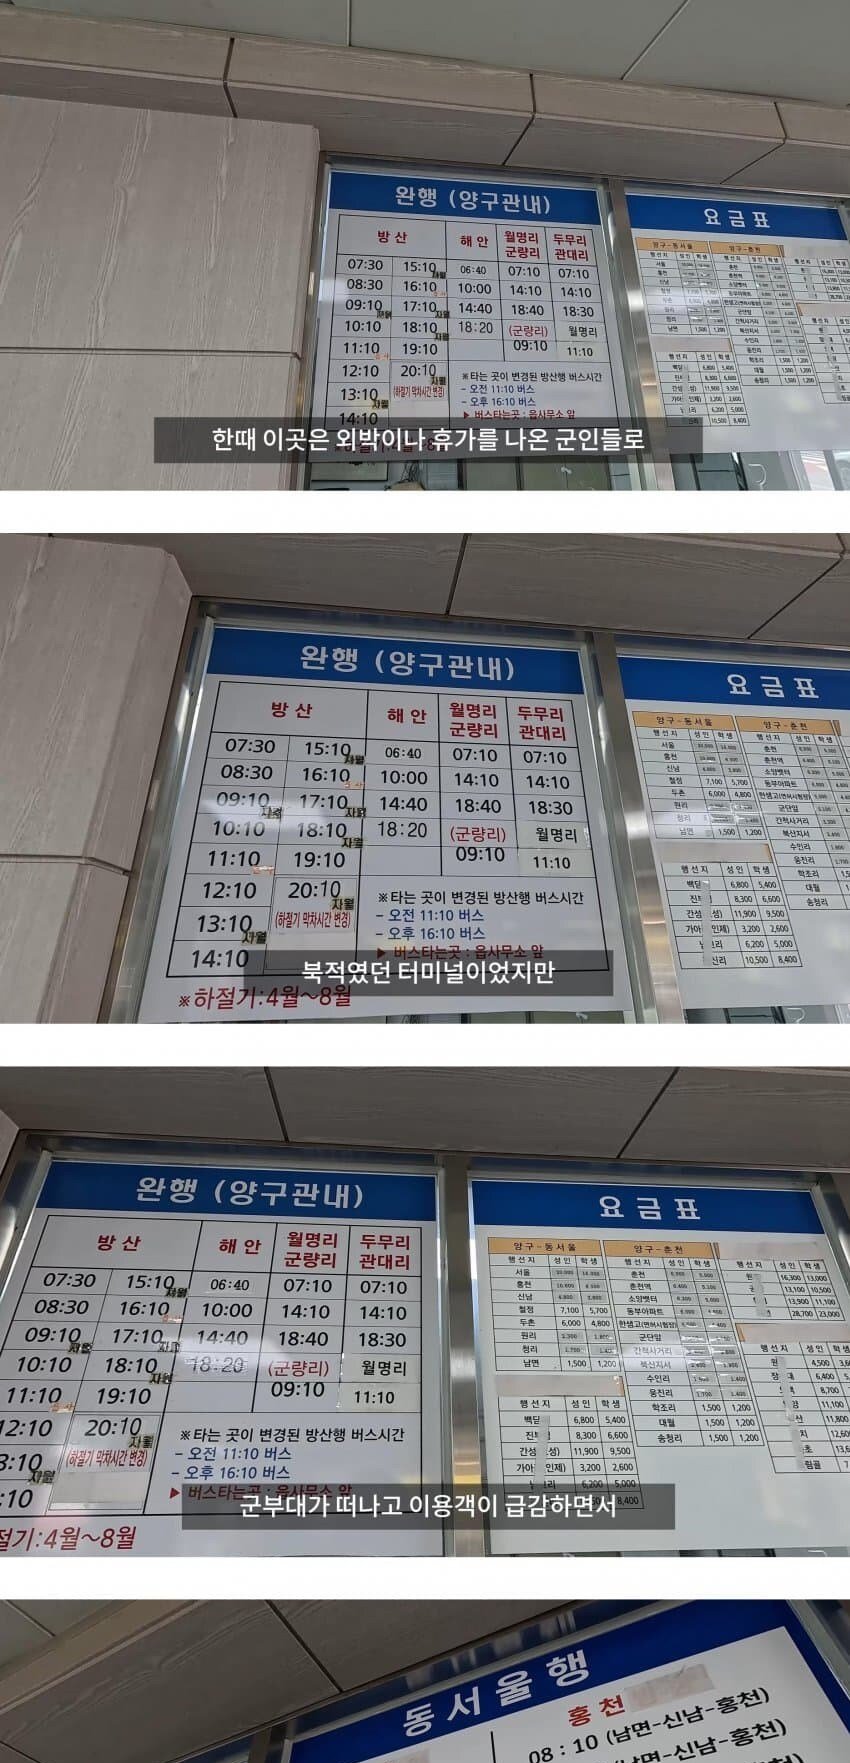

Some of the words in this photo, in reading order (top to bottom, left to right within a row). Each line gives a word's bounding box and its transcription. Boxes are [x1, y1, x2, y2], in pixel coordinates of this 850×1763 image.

[395, 186, 438, 208] 완행
[449, 189, 550, 215] (양구관내)
[504, 230, 538, 244] 월명리
[508, 266, 540, 278] 07:10
[300, 645, 358, 673] 완행
[375, 650, 514, 681] (양구관내)
[450, 702, 496, 719] 월명리
[517, 706, 564, 722] 두무리
[450, 722, 498, 739] 군량리
[519, 725, 566, 741] 관대리
[225, 738, 276, 754] 07:30
[304, 742, 351, 756] 15:10
[385, 747, 422, 759] 06:40
[452, 748, 498, 762] 07:10
[523, 751, 567, 765] 07:10
[221, 764, 273, 780] 08:30
[302, 768, 350, 782] 16:10
[381, 770, 428, 785] 10:00
[454, 773, 499, 788] 14:10
[526, 776, 570, 790] 14:10
[216, 792, 270, 808] 09:10
[300, 794, 348, 810] 17:10
[380, 796, 428, 812] 14:40
[456, 799, 502, 814] 18:40
[528, 801, 573, 816] 18:30
[213, 820, 266, 837] 10:10
[298, 823, 348, 838] 18:10
[378, 822, 428, 838] 18:20
[450, 825, 506, 843] (군량리)
[536, 827, 578, 843] 월명리
[208, 850, 260, 867] 11:10
[294, 852, 346, 868] 19:10
[456, 846, 506, 862] 09:10
[533, 856, 571, 870] 11:10
[203, 882, 256, 899] 12:10
[288, 880, 341, 899] 20:10
[420, 890, 446, 904] 곳이
[450, 890, 489, 906] 변경된
[493, 891, 530, 906] 방산행
[534, 892, 584, 906] 버스시간
[197, 914, 252, 933] 13:10
[274, 911, 300, 928] (하절기
[302, 911, 332, 928] 막차시간
[334, 911, 351, 928] 변경)
[388, 909, 414, 922] 오전
[420, 910, 454, 922] 11:10
[458, 910, 484, 922] 버스
[388, 927, 416, 940] 오후
[420, 928, 455, 940] 16:10
[459, 928, 486, 940] 버스
[192, 950, 249, 968] 14:10
[393, 944, 460, 960] 버스타는곳
[475, 944, 528, 960] 읍사무소
[531, 944, 544, 958] 앞
[136, 1176, 198, 1204] 완행
[214, 1178, 364, 1209] (양구관내)
[360, 1234, 410, 1250] 두무리
[282, 1304, 330, 1319] 14:10
[560, 1306, 580, 1315] 7,100
[589, 1306, 608, 1315] 5,700
[561, 1319, 581, 1328] 6,000
[97, 1388, 152, 1404] 19:10
[701, 1404, 722, 1412] 1,500
[606, 1687, 770, 1746] (남면-신남-홍천)
